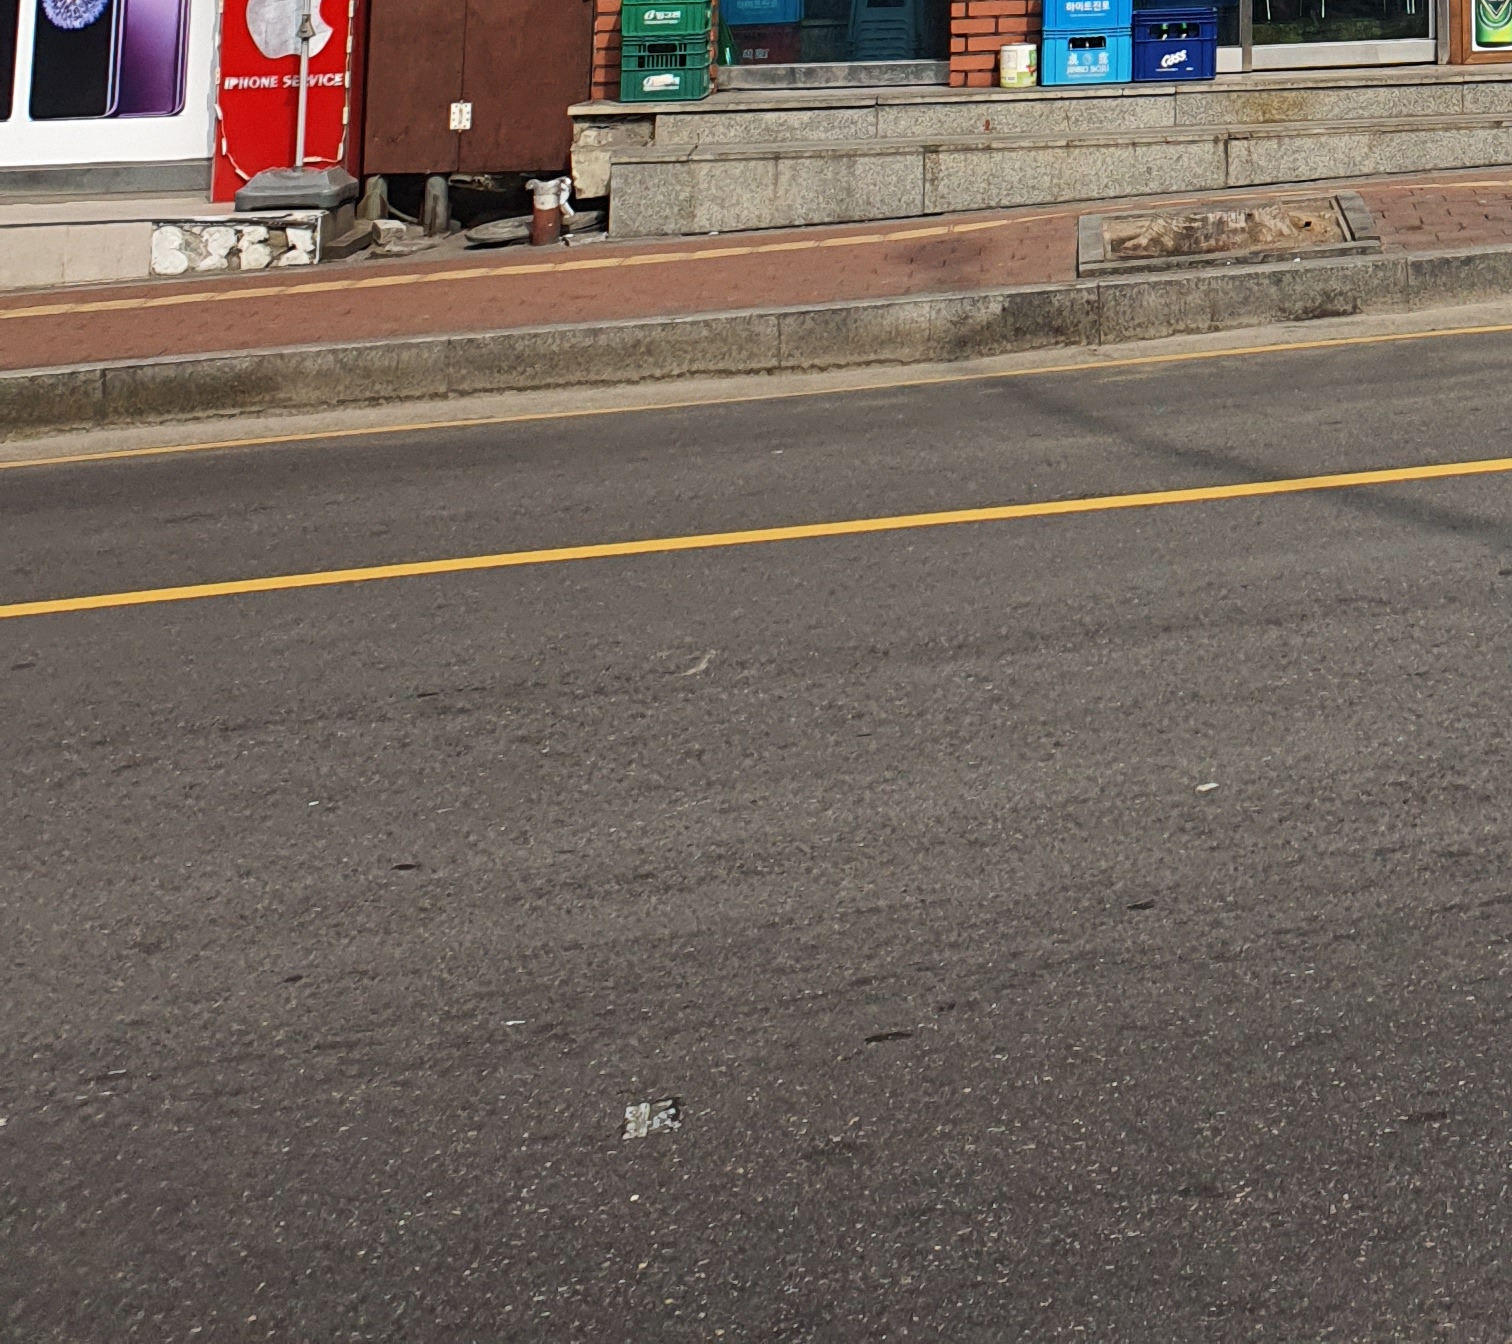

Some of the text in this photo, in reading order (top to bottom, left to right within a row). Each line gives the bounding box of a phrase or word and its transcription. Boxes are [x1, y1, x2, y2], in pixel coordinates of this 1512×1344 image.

[1161, 49, 1188, 68] Cass
[224, 73, 344, 90] IPHONE SEVICE
